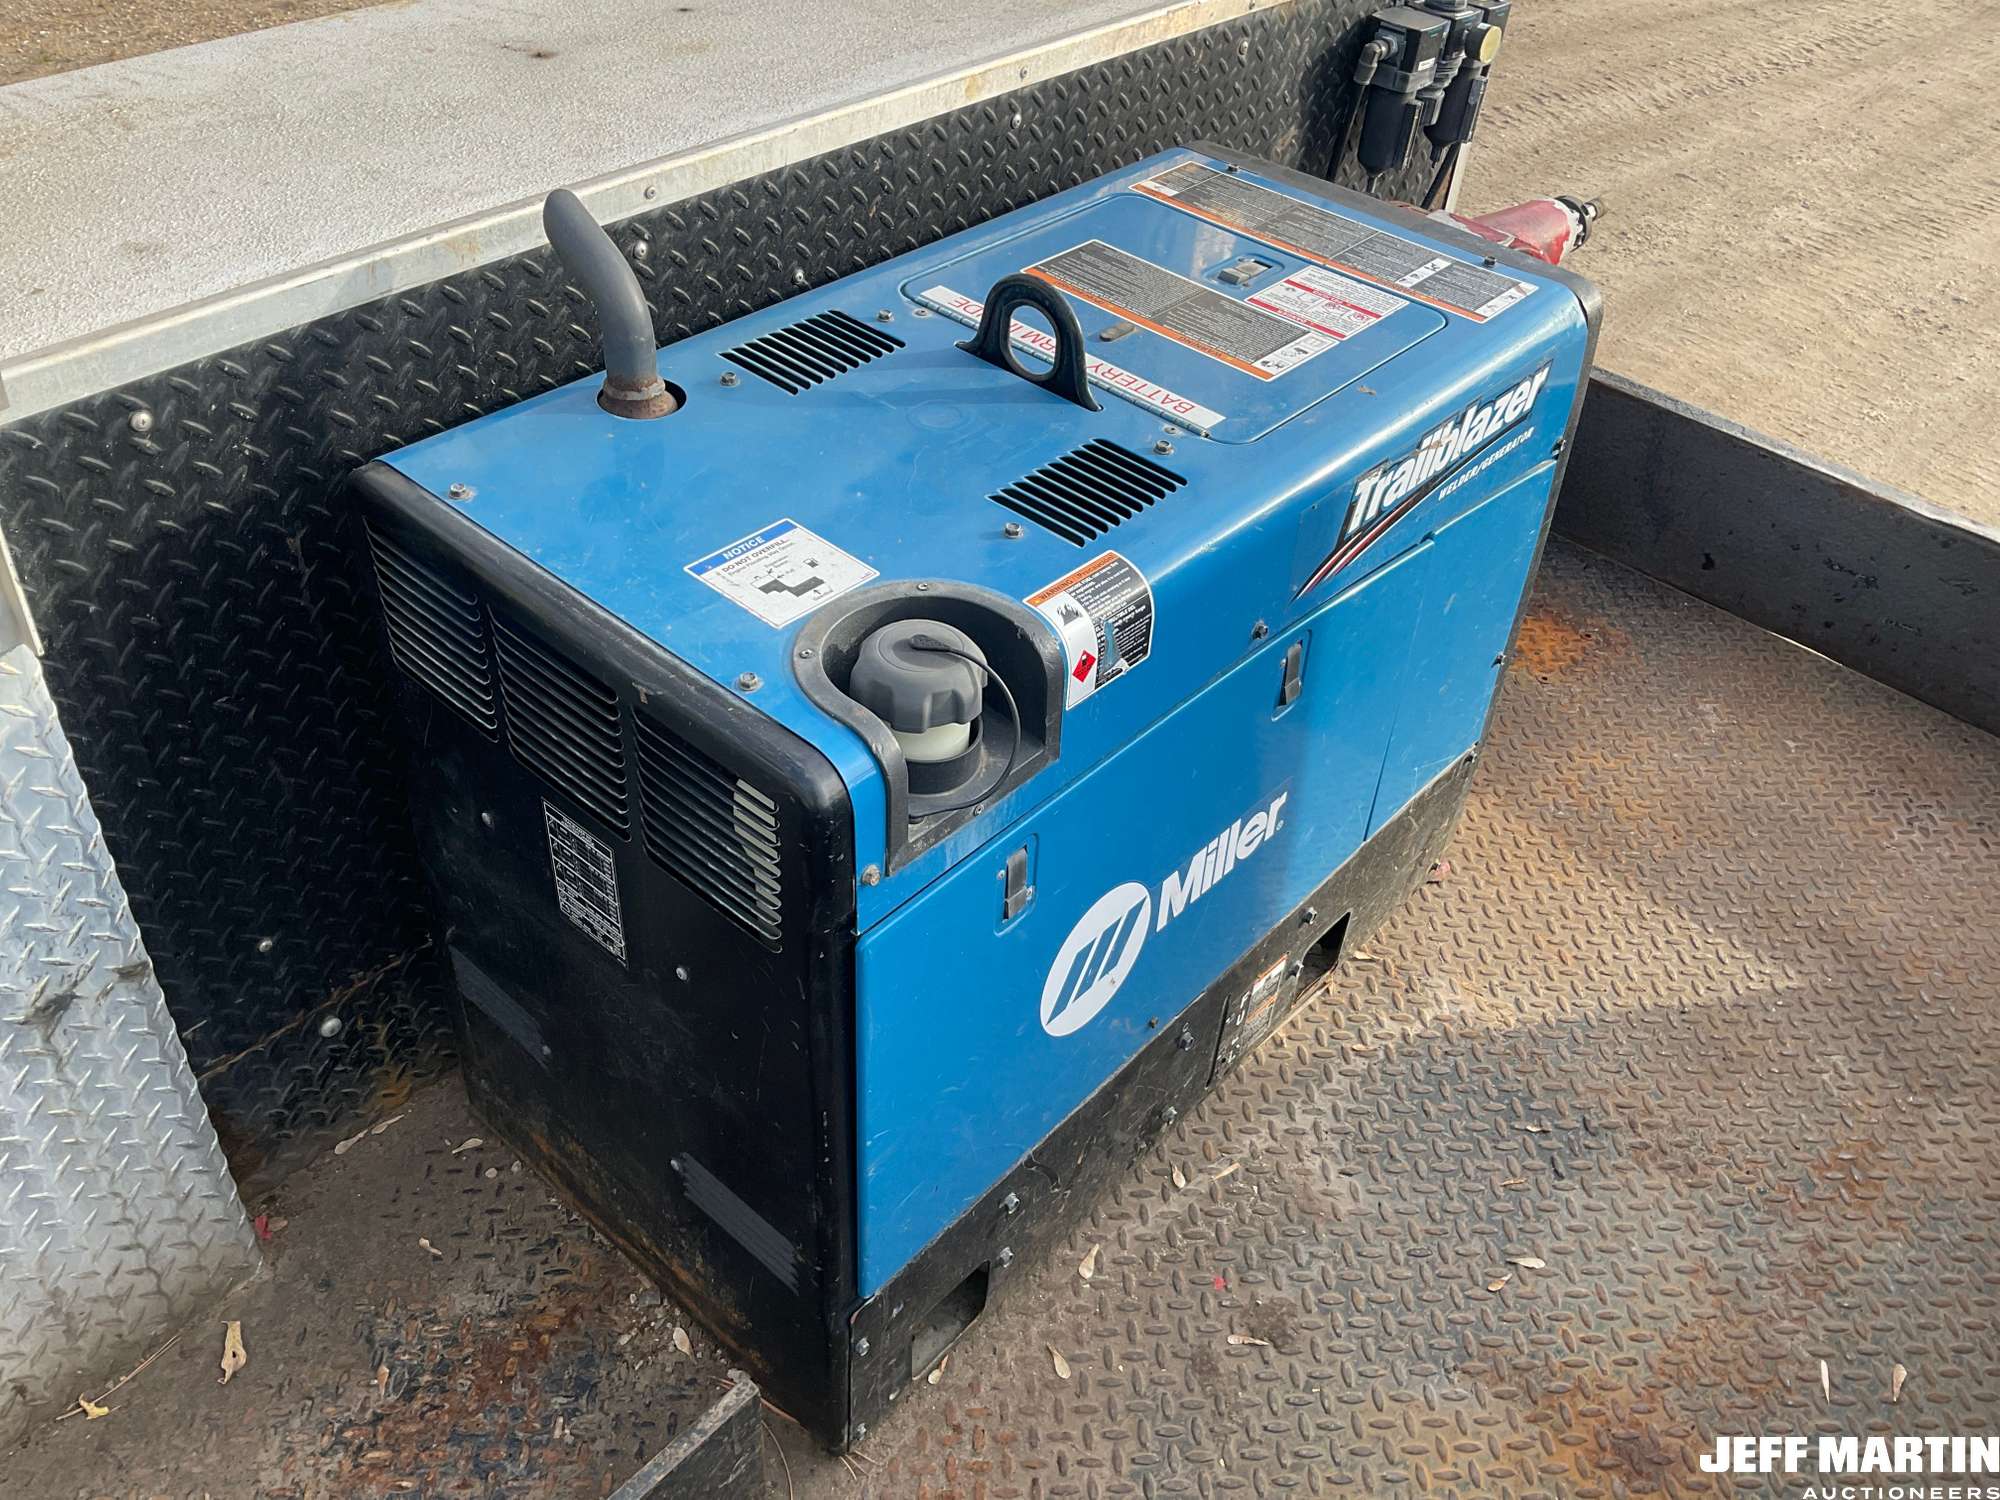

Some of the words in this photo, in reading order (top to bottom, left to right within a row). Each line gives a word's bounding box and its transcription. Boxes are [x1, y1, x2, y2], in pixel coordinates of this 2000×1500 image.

[1086, 363, 1196, 414] BATTERY
[1346, 366, 1549, 535] Trailblazer
[1438, 426, 1534, 501] WELDER/GENERATOR
[722, 535, 766, 560] NOTICE
[722, 564, 735, 573] DO
[735, 555, 751, 567] NOT
[1040, 579, 1073, 600] WARNING
[1156, 792, 1287, 932] Miller
